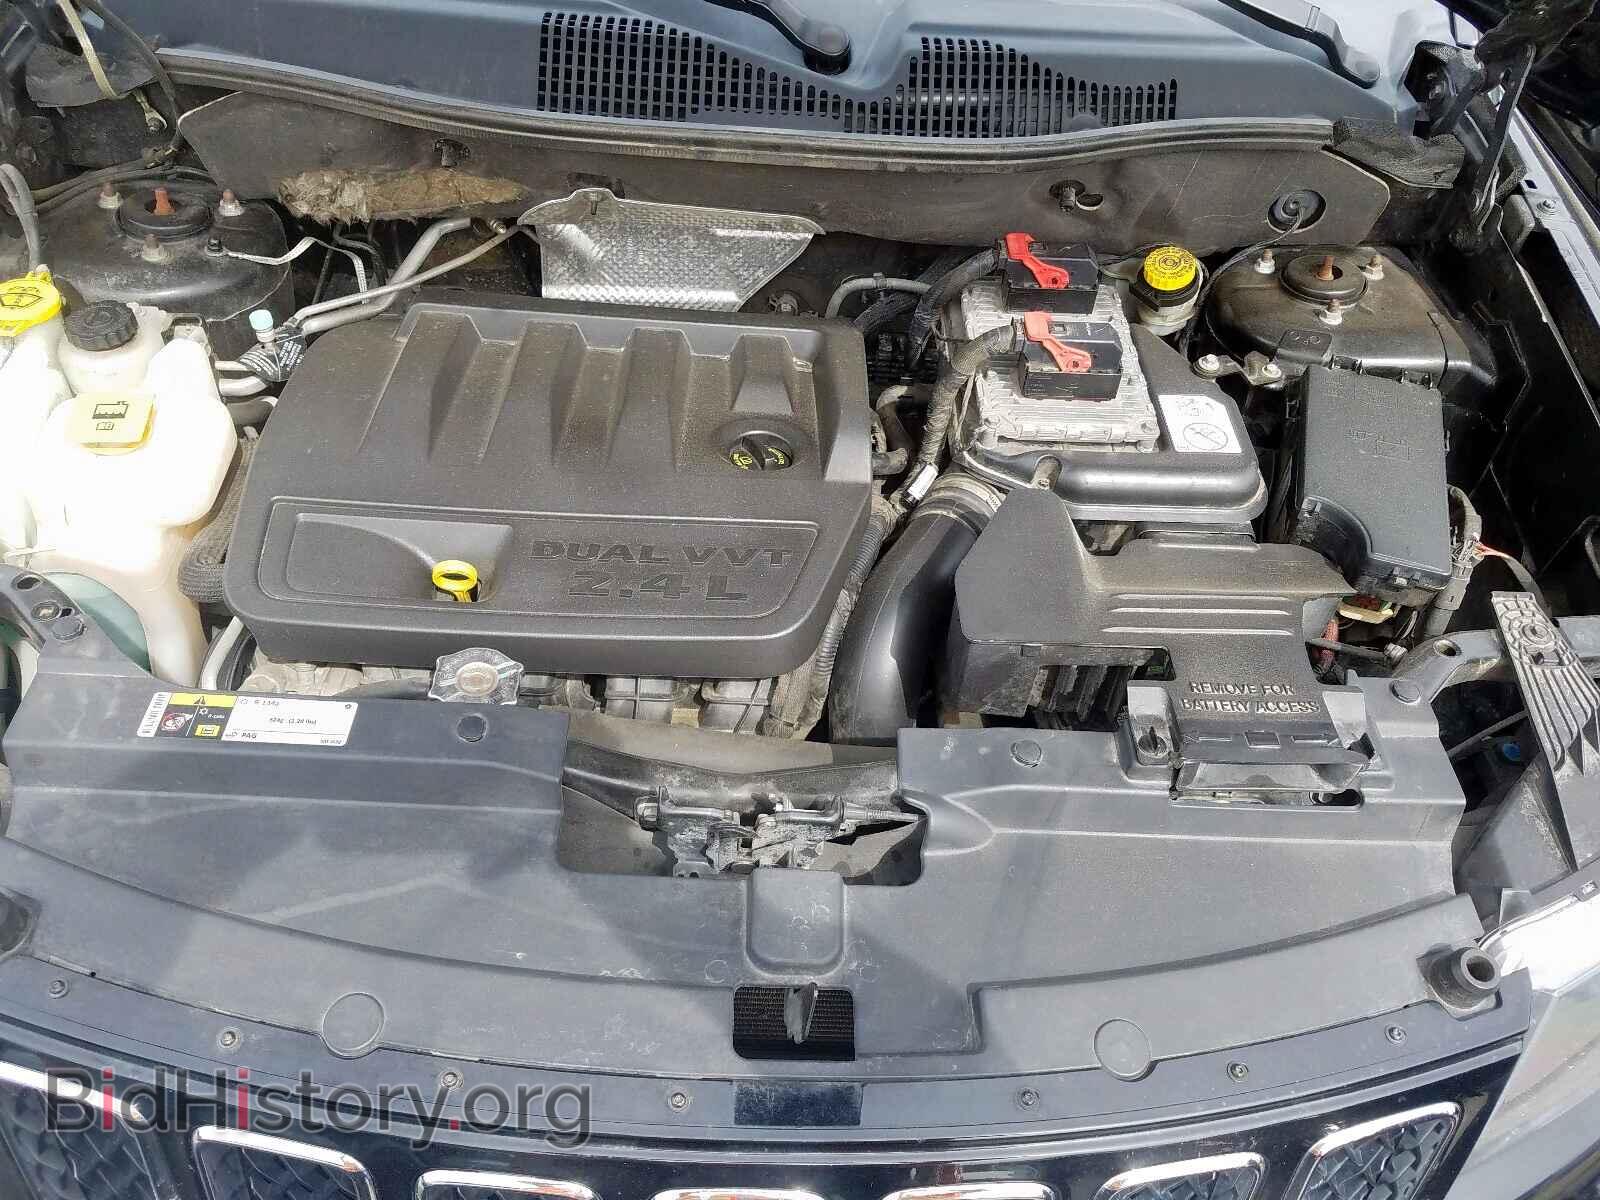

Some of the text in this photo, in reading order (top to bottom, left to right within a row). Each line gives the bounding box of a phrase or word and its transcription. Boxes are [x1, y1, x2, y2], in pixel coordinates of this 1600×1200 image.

[530, 541, 793, 567] DUAL VVT
[1190, 681, 1295, 697] REMOVE FOR
[1182, 698, 1320, 714] BATTERY ACCESS
